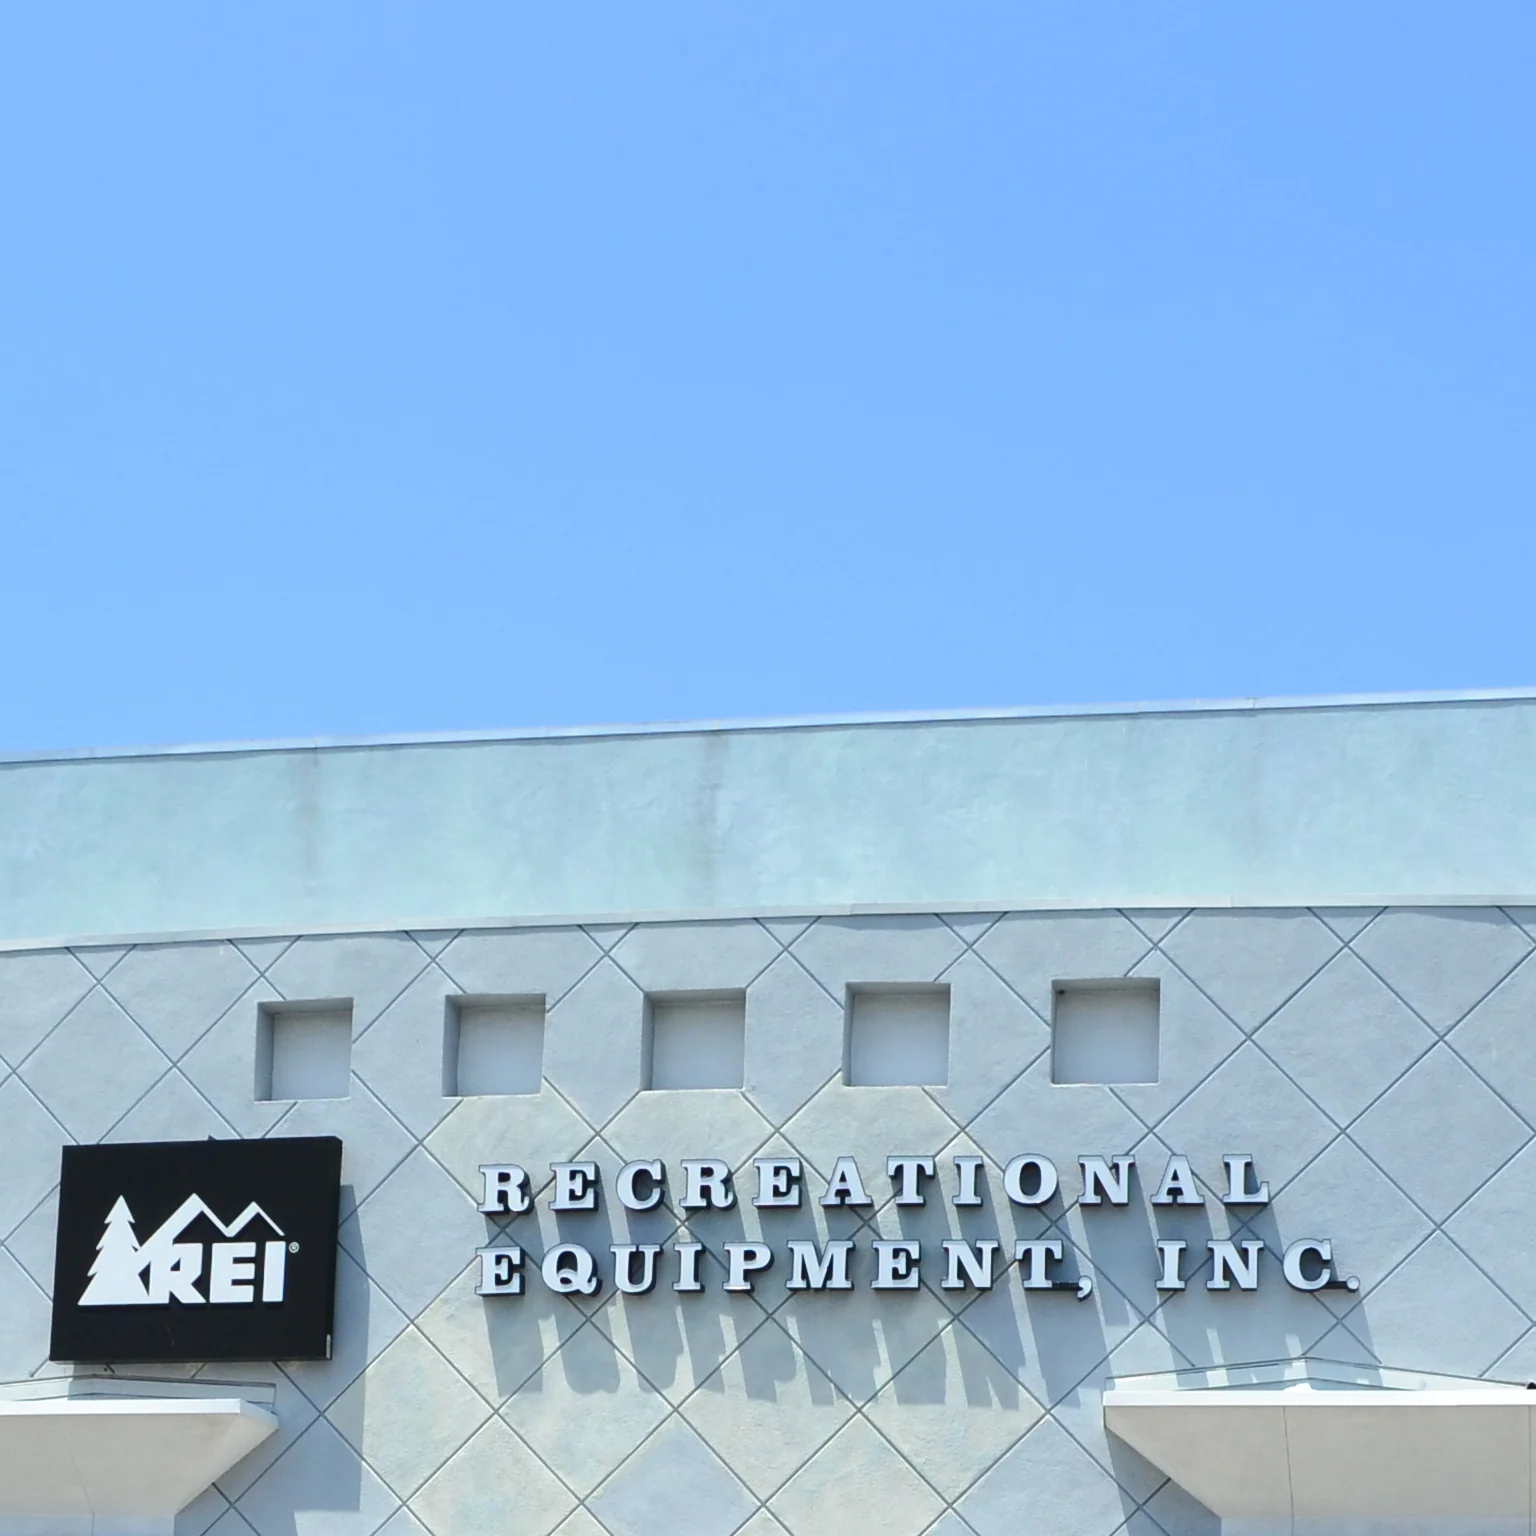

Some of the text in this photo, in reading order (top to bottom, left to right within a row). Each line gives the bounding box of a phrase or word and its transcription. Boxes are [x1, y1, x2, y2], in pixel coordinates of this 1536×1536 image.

[477, 1153, 1270, 1213] RECREATIONAL
[149, 1239, 286, 1304] REI
[475, 1238, 1361, 1300] EQUIPMENT, INC.
